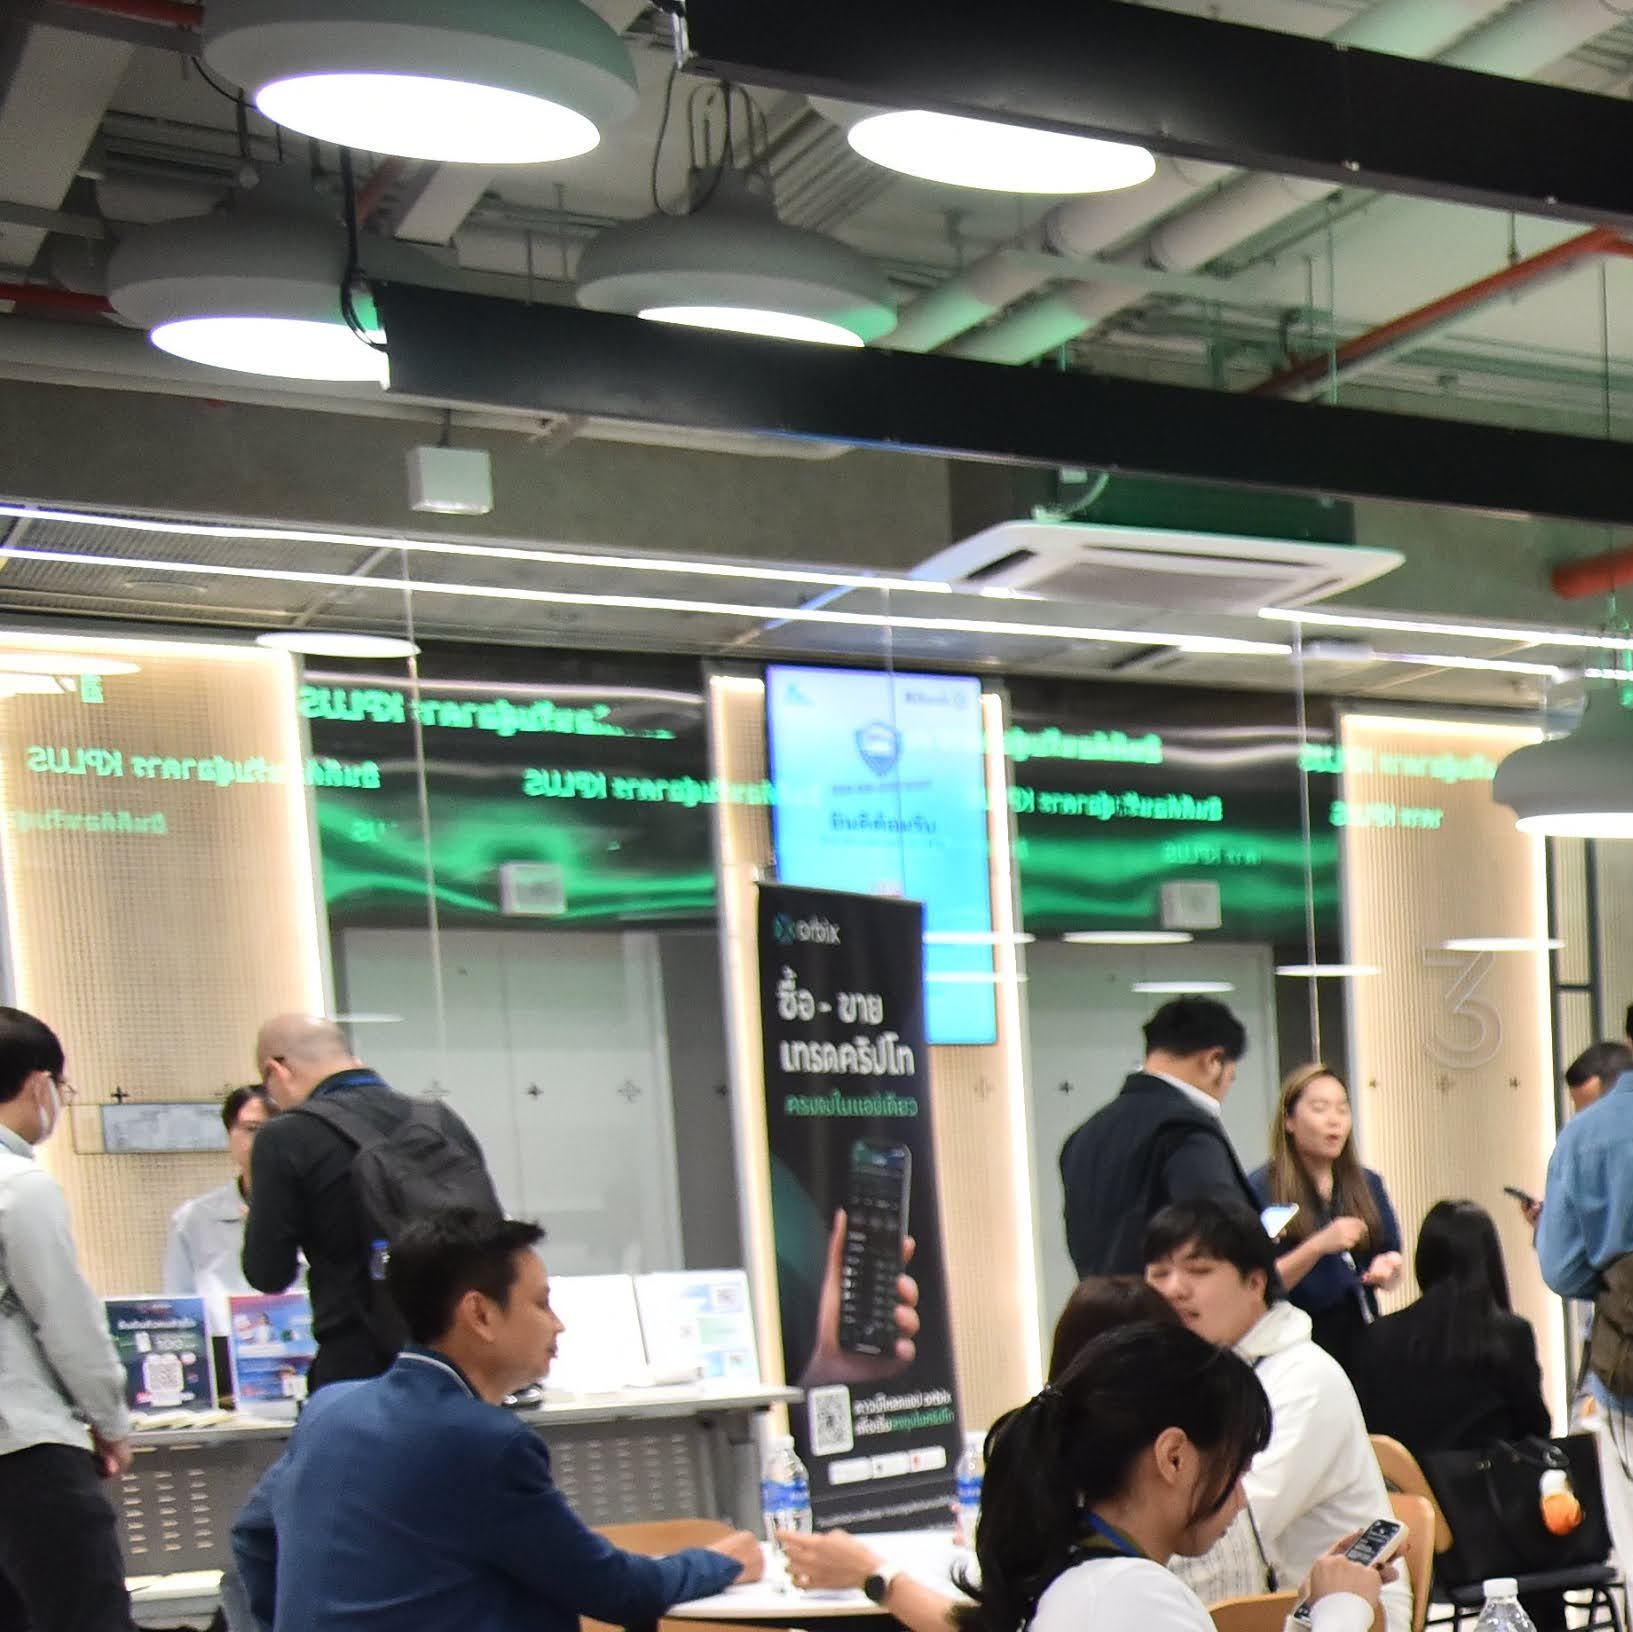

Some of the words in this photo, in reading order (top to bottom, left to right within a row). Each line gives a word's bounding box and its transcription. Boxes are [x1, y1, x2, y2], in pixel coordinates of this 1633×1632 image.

[796, 915, 841, 944] orbix
[776, 964, 816, 1022] ซื้อ
[836, 991, 884, 1026] ขาย
[1422, 944, 1503, 1069] 3
[780, 1031, 915, 1076] เทรดคริปโท
